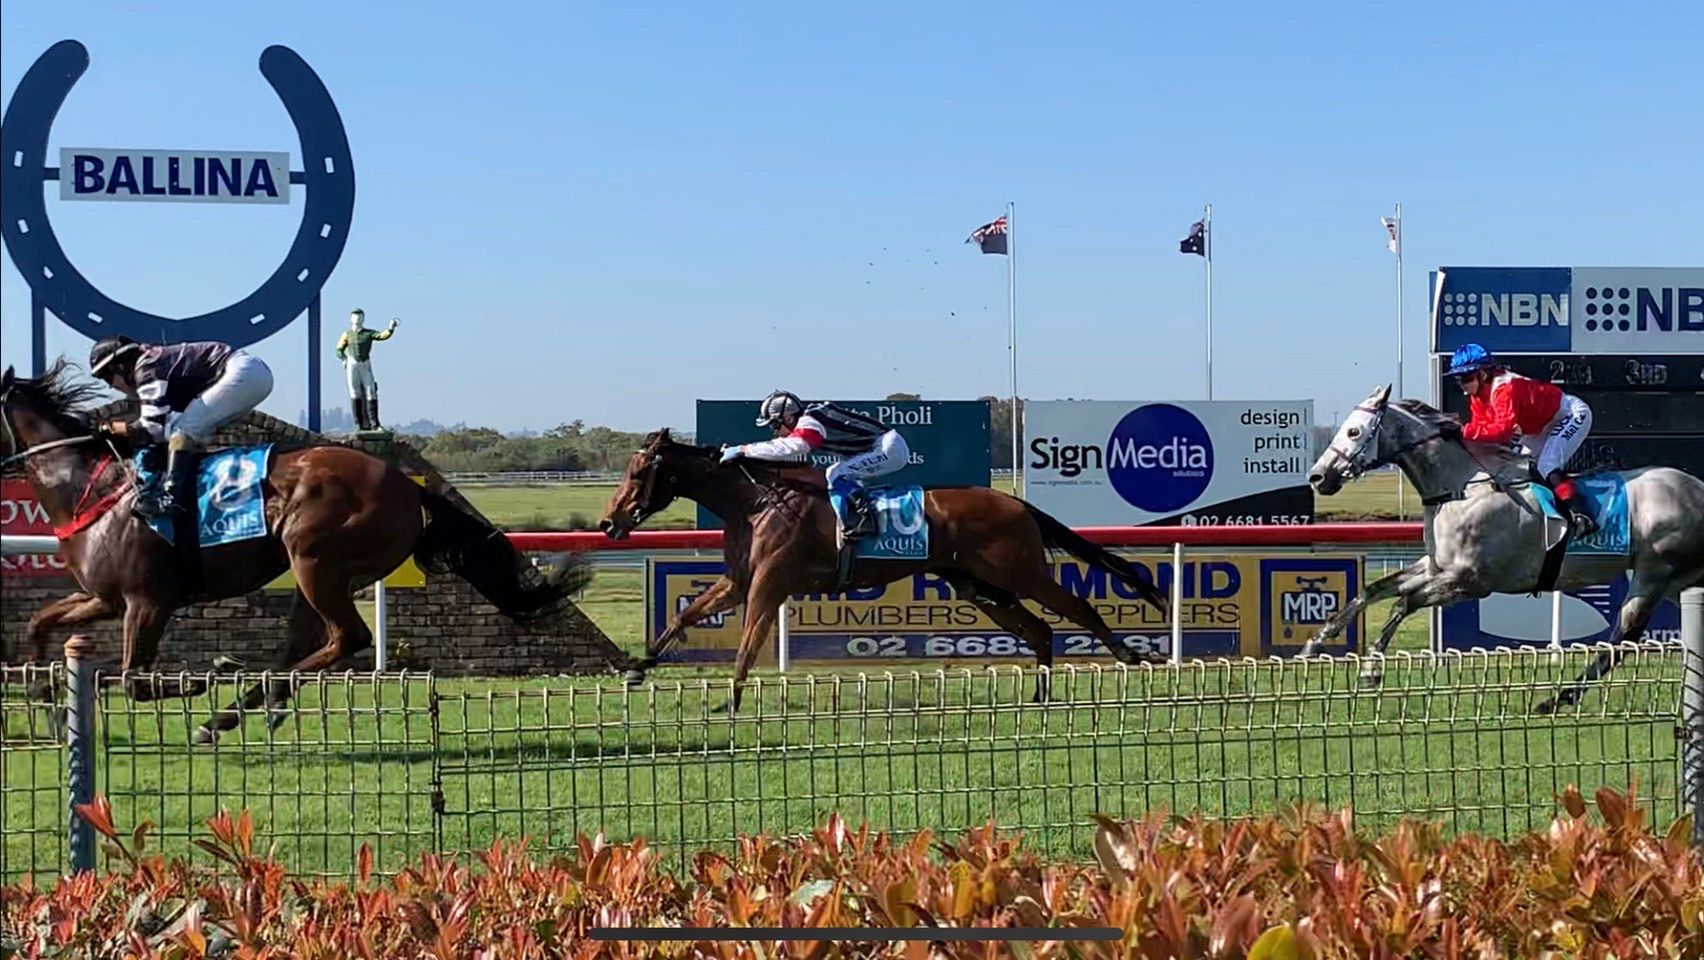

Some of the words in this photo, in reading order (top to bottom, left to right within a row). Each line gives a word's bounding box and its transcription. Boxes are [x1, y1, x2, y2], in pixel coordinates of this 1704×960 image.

[74, 155, 278, 197] BALLINA
[1481, 293, 1569, 326] NBN
[877, 403, 932, 425] Pholi
[1241, 409, 1299, 428] design
[1255, 433, 1300, 453] print
[1030, 437, 1103, 477] Sign
[1110, 436, 1208, 469] Media
[1244, 457, 1299, 473] install
[875, 492, 924, 535] 10
[1584, 480, 1617, 530] 7
[1200, 515, 1219, 526] 02
[1225, 515, 1263, 526] 6681
[1271, 515, 1310, 526] 5567
[874, 536, 924, 554] AQUIS
[1041, 603, 1241, 625] SPPLIERS
[1284, 592, 1336, 620] MRP
[847, 636, 906, 657] 02
